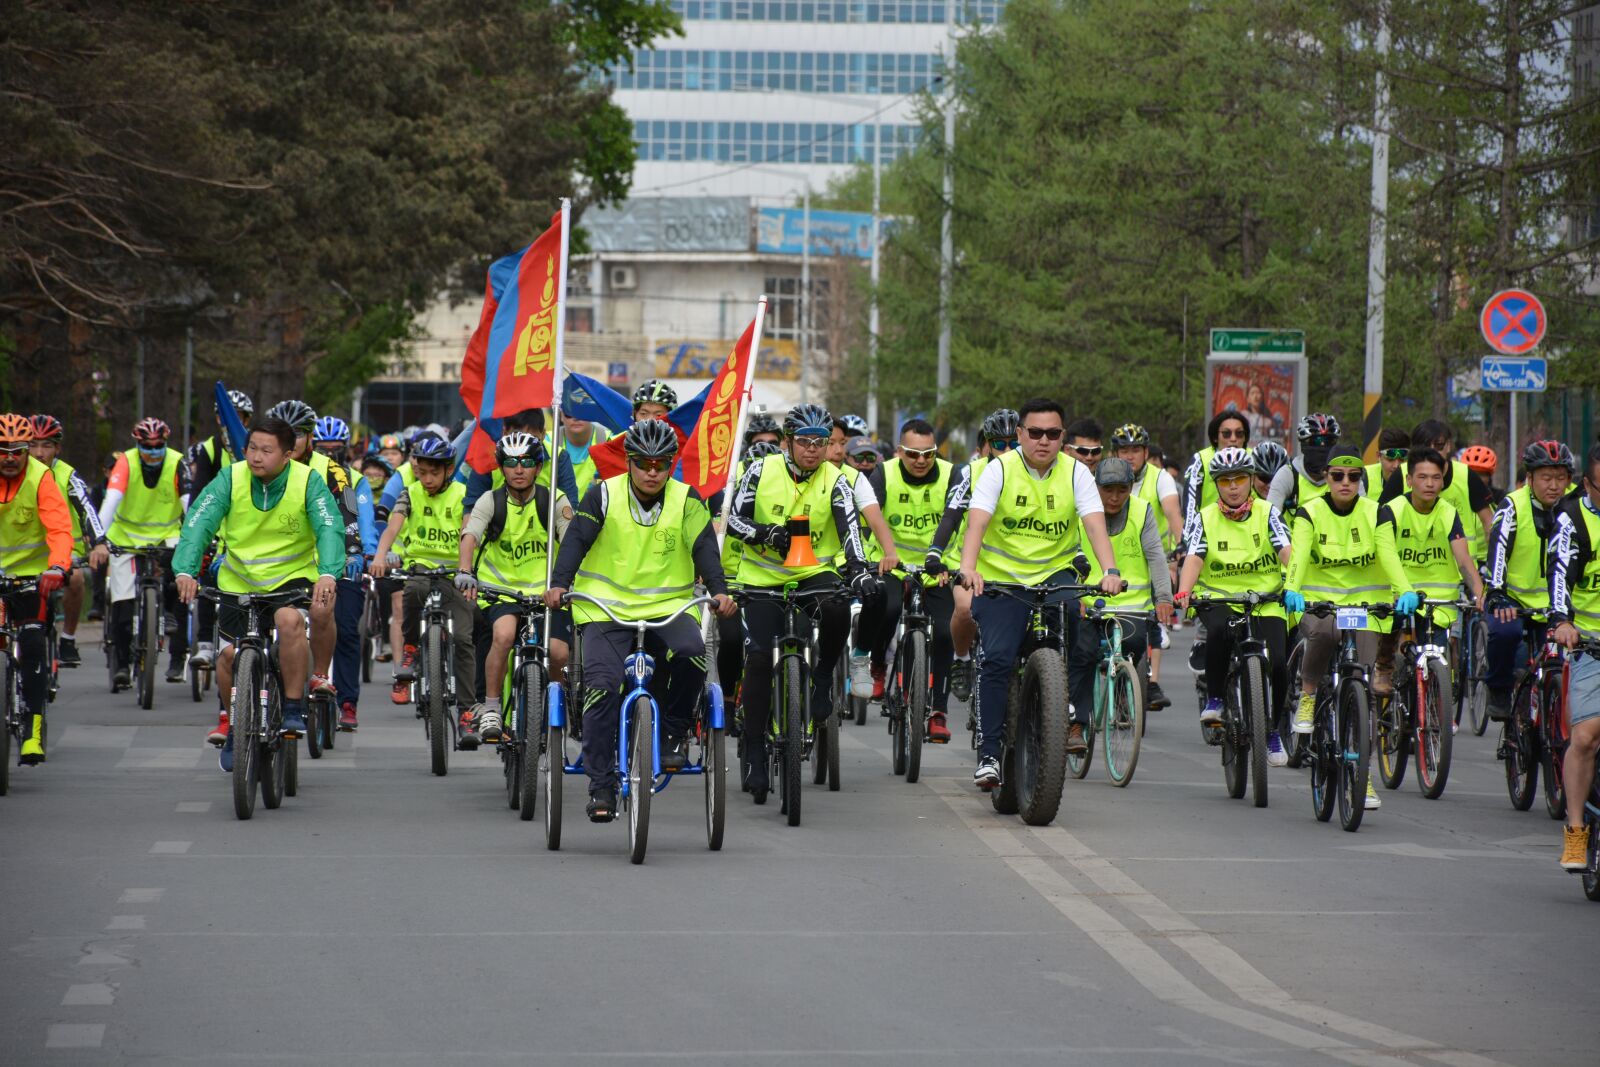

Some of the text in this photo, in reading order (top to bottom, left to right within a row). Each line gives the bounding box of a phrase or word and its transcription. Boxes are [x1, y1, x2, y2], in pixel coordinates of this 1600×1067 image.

[1017, 517, 1070, 536] BIOFIN
[1225, 552, 1278, 572] BIOFIN
[1402, 547, 1447, 564] BIOFIN
